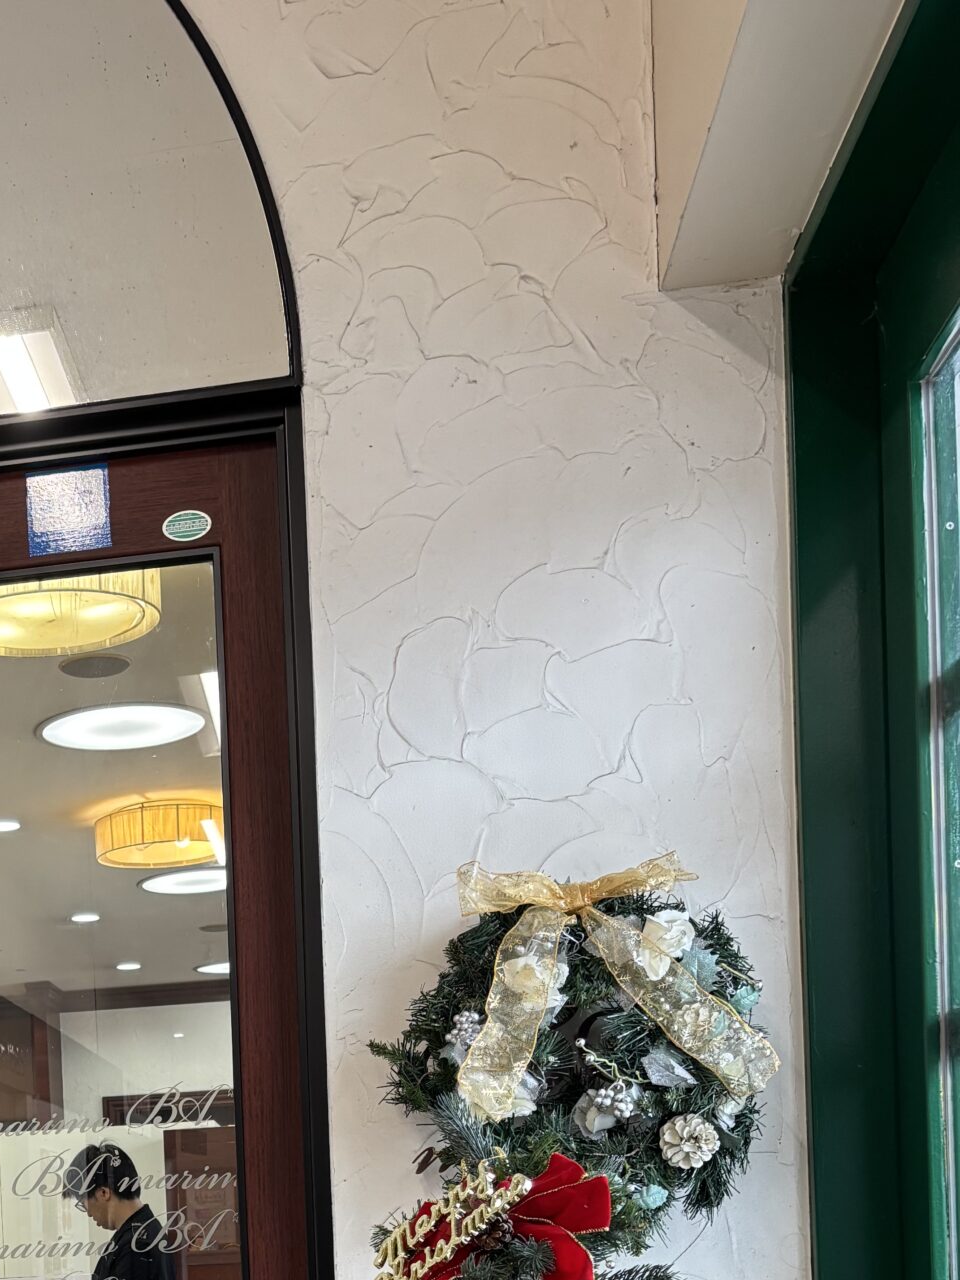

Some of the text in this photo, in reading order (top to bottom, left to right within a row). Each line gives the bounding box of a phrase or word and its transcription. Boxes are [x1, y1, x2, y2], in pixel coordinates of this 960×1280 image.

[125, 1081, 233, 1128] BA
[11, 1149, 114, 1198] BA
[130, 1206, 235, 1253] BA
